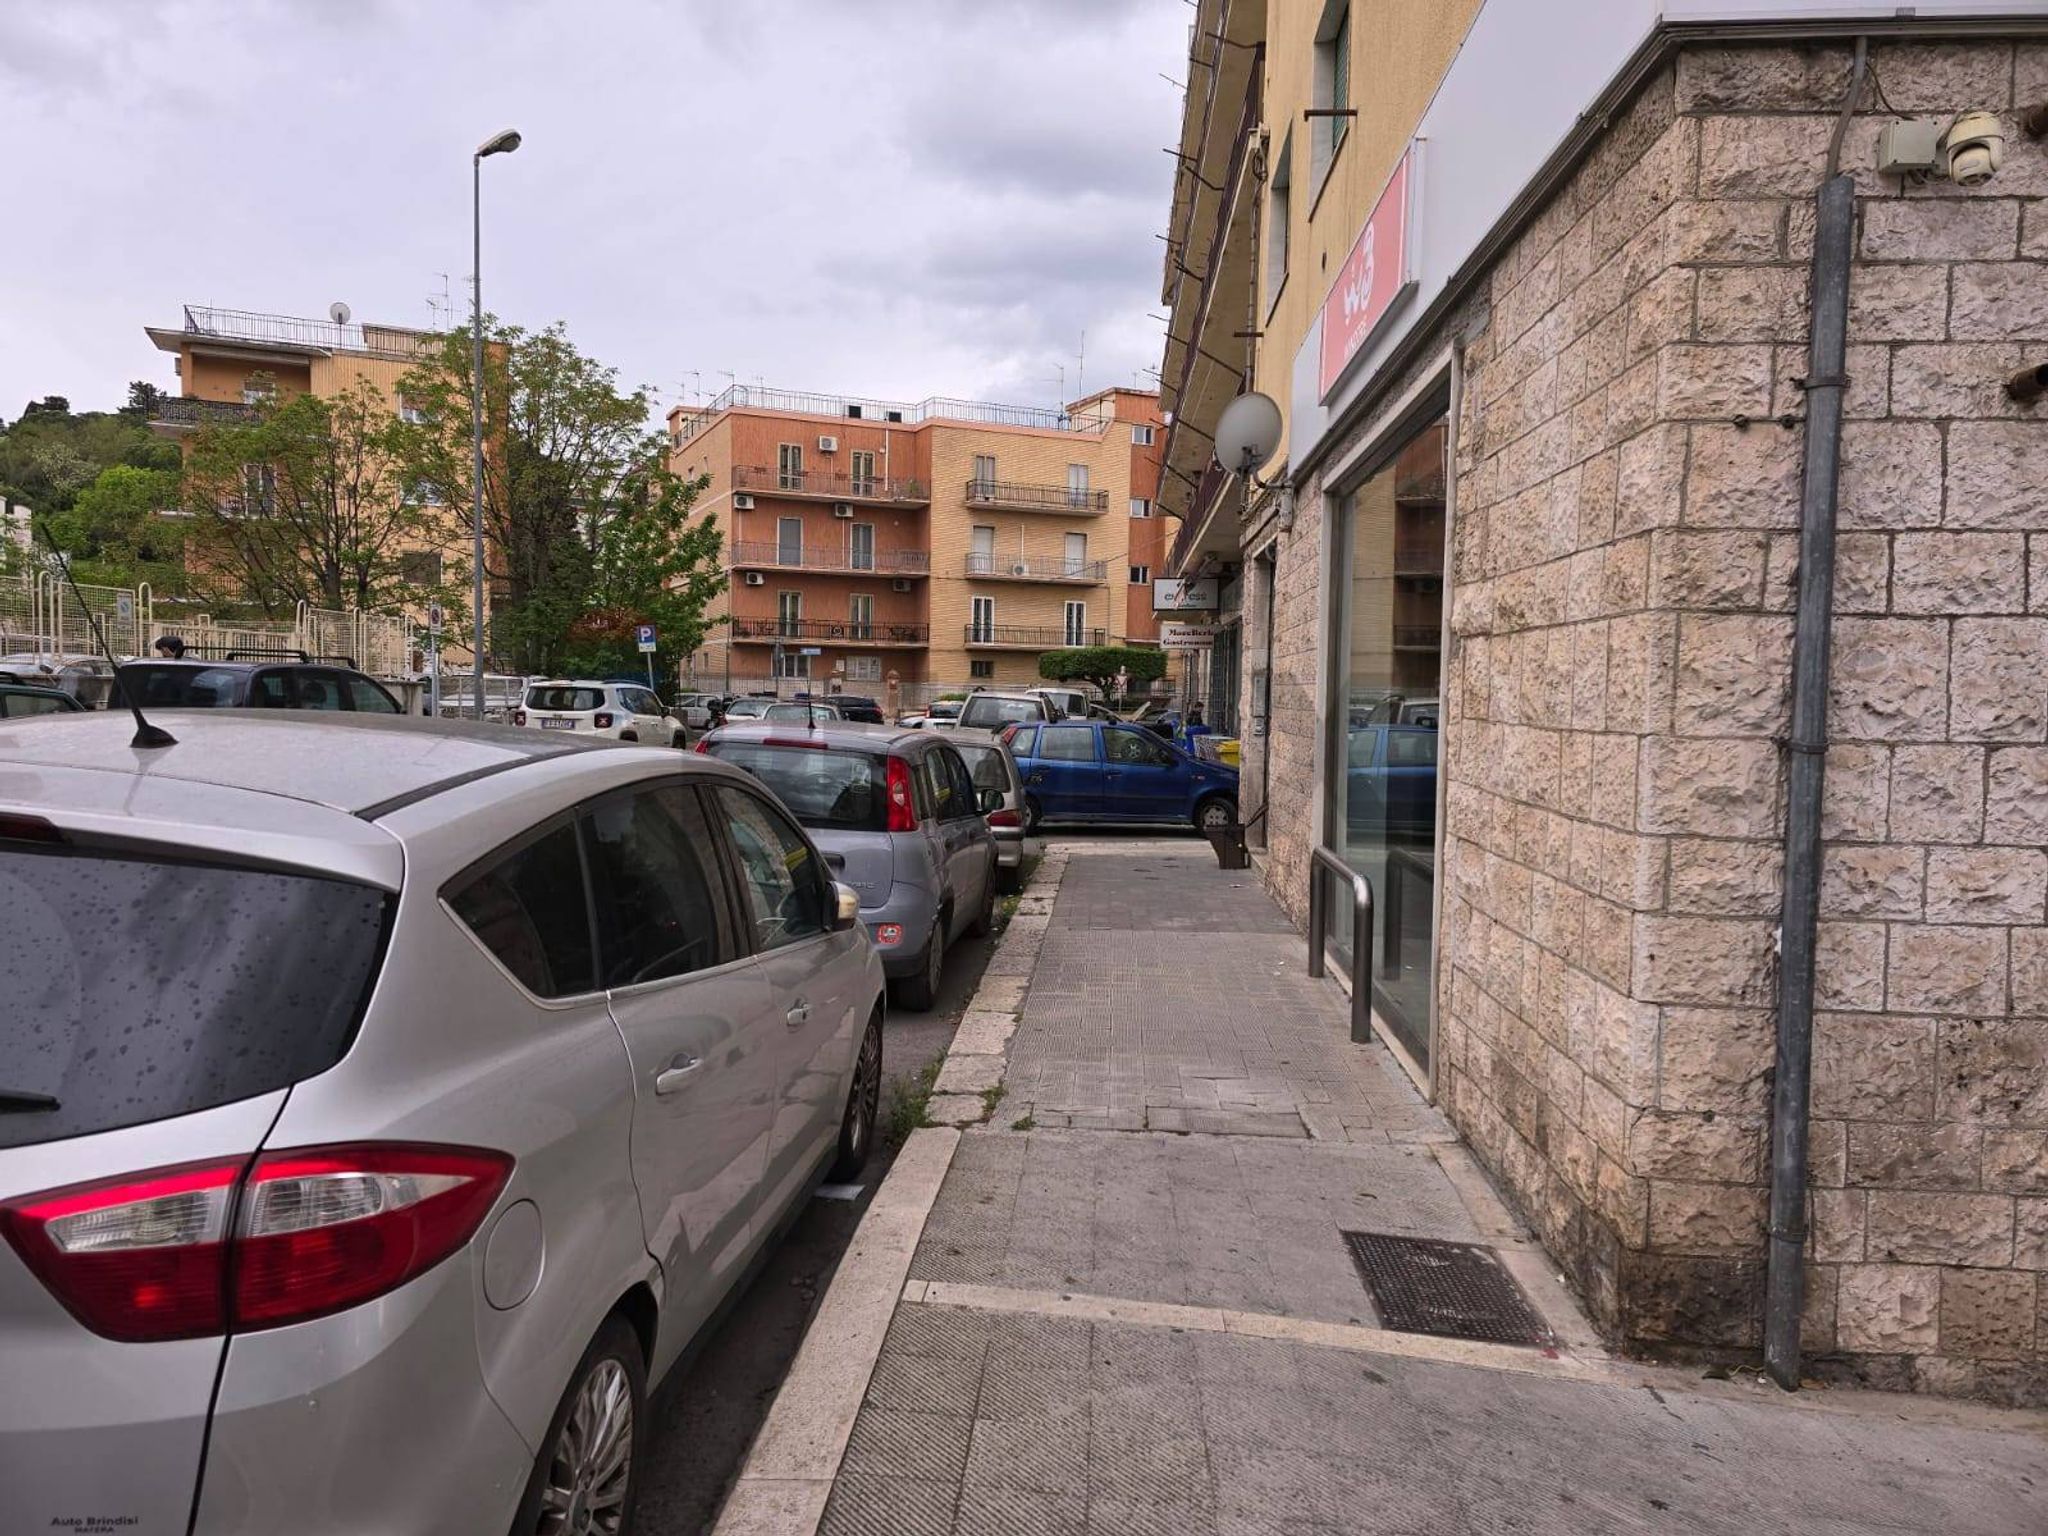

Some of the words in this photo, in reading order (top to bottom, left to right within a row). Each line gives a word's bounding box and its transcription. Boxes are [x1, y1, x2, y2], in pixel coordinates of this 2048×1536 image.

[640, 627, 652, 642] P
[51, 1517, 83, 1526] Auto
[87, 1517, 139, 1526] Brindisi
